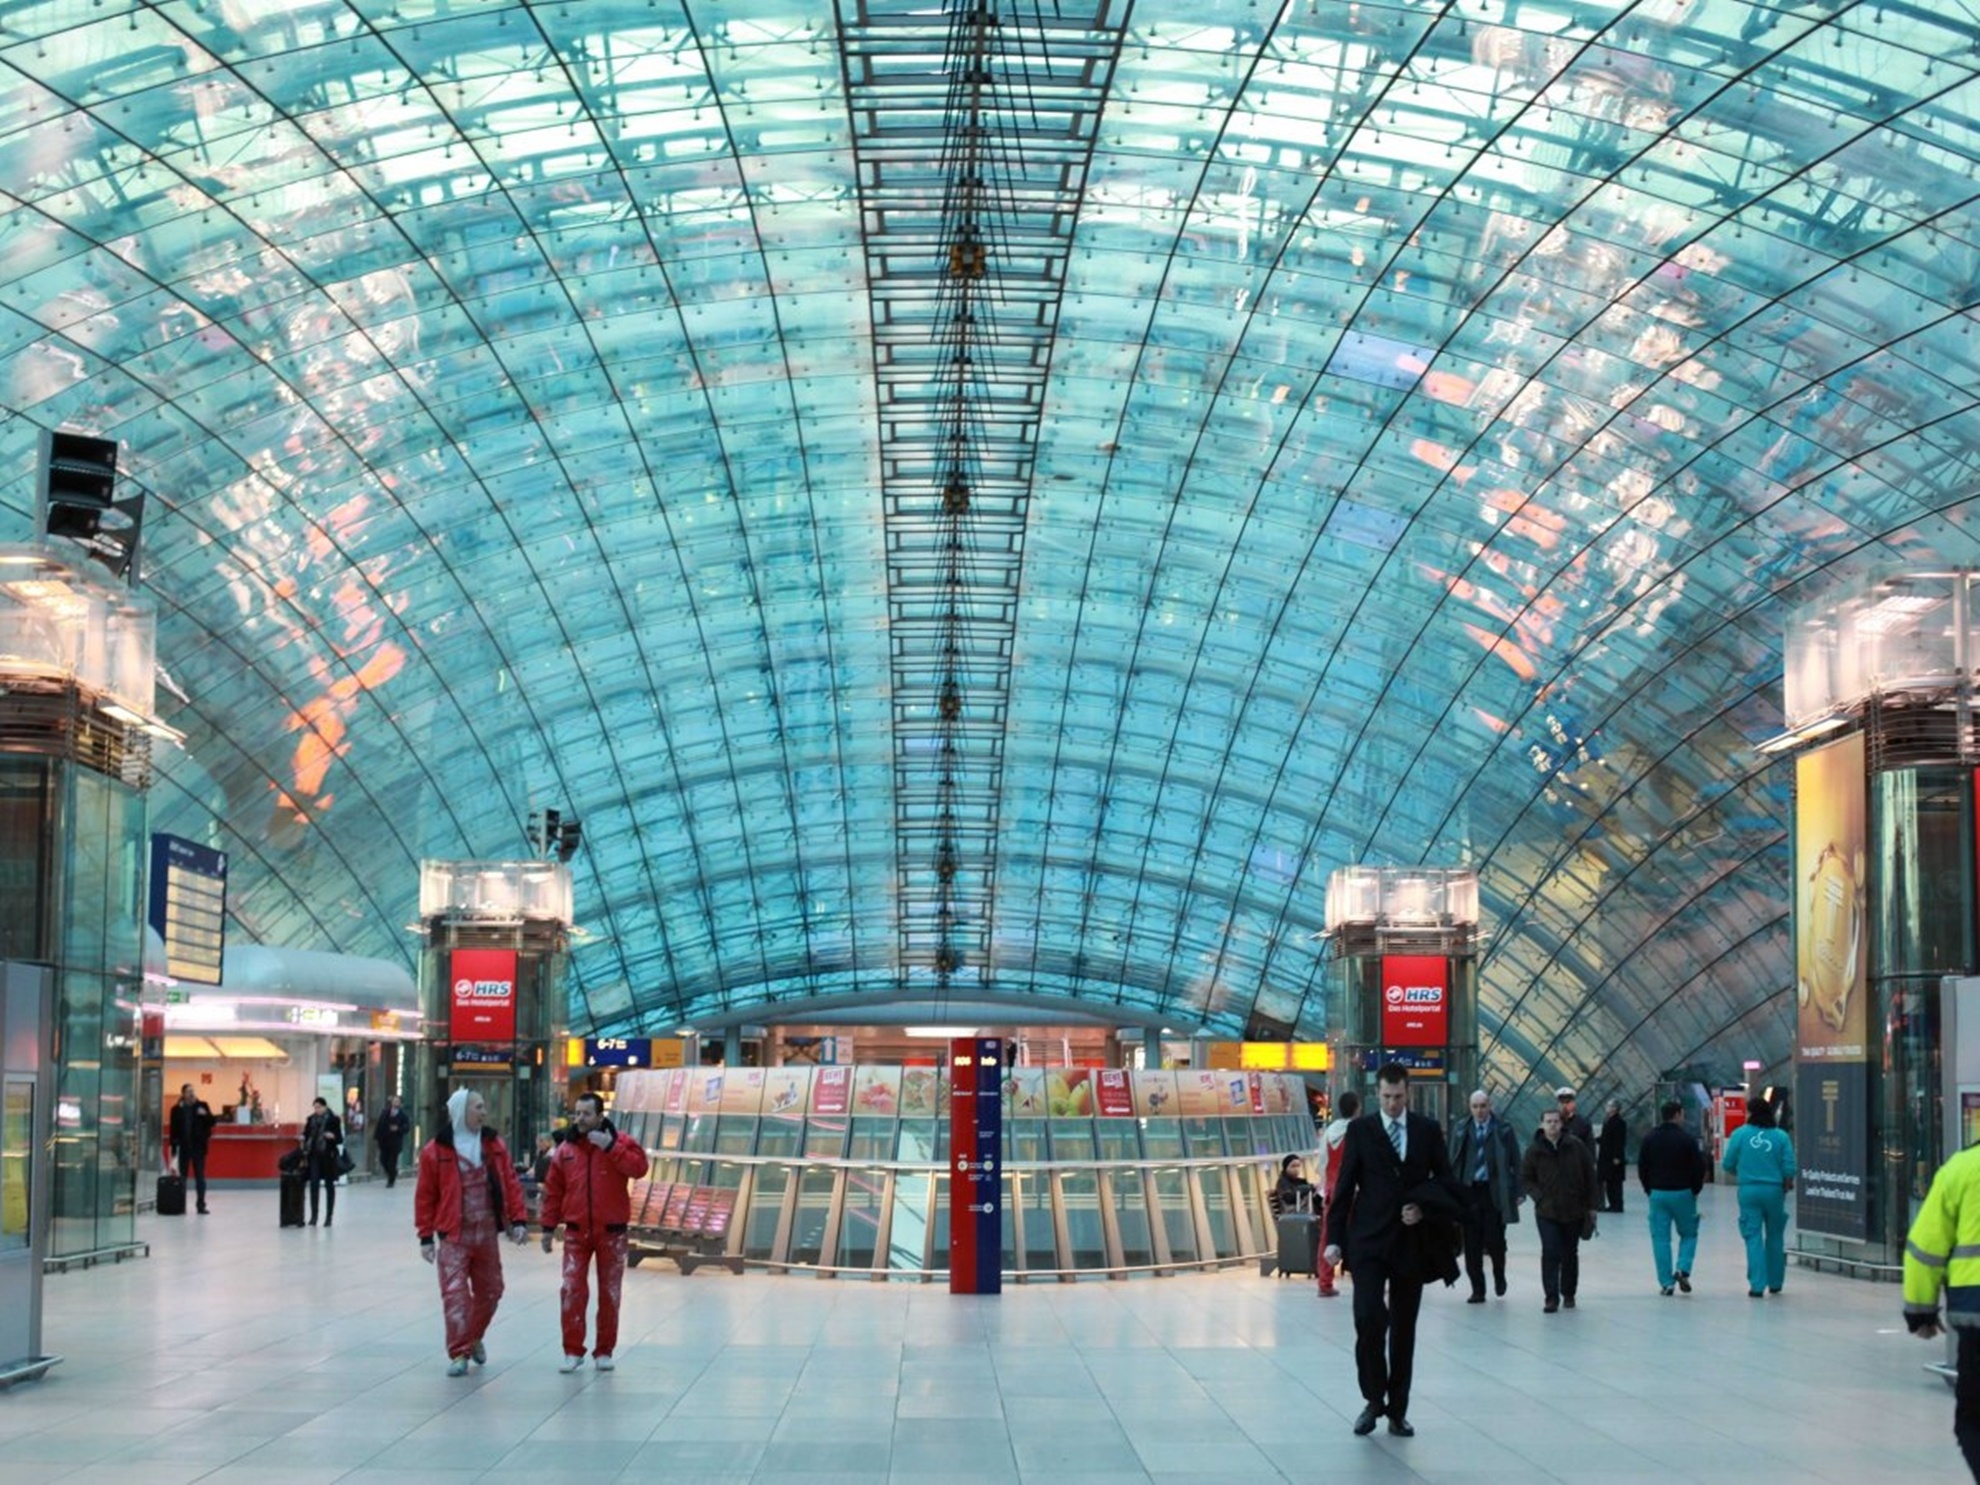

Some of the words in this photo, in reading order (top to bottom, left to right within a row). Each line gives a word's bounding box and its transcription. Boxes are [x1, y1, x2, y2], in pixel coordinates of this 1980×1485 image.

[474, 981, 511, 997] HRS
[1406, 987, 1442, 1001] HRS
[597, 1038, 616, 1050] 6-7
